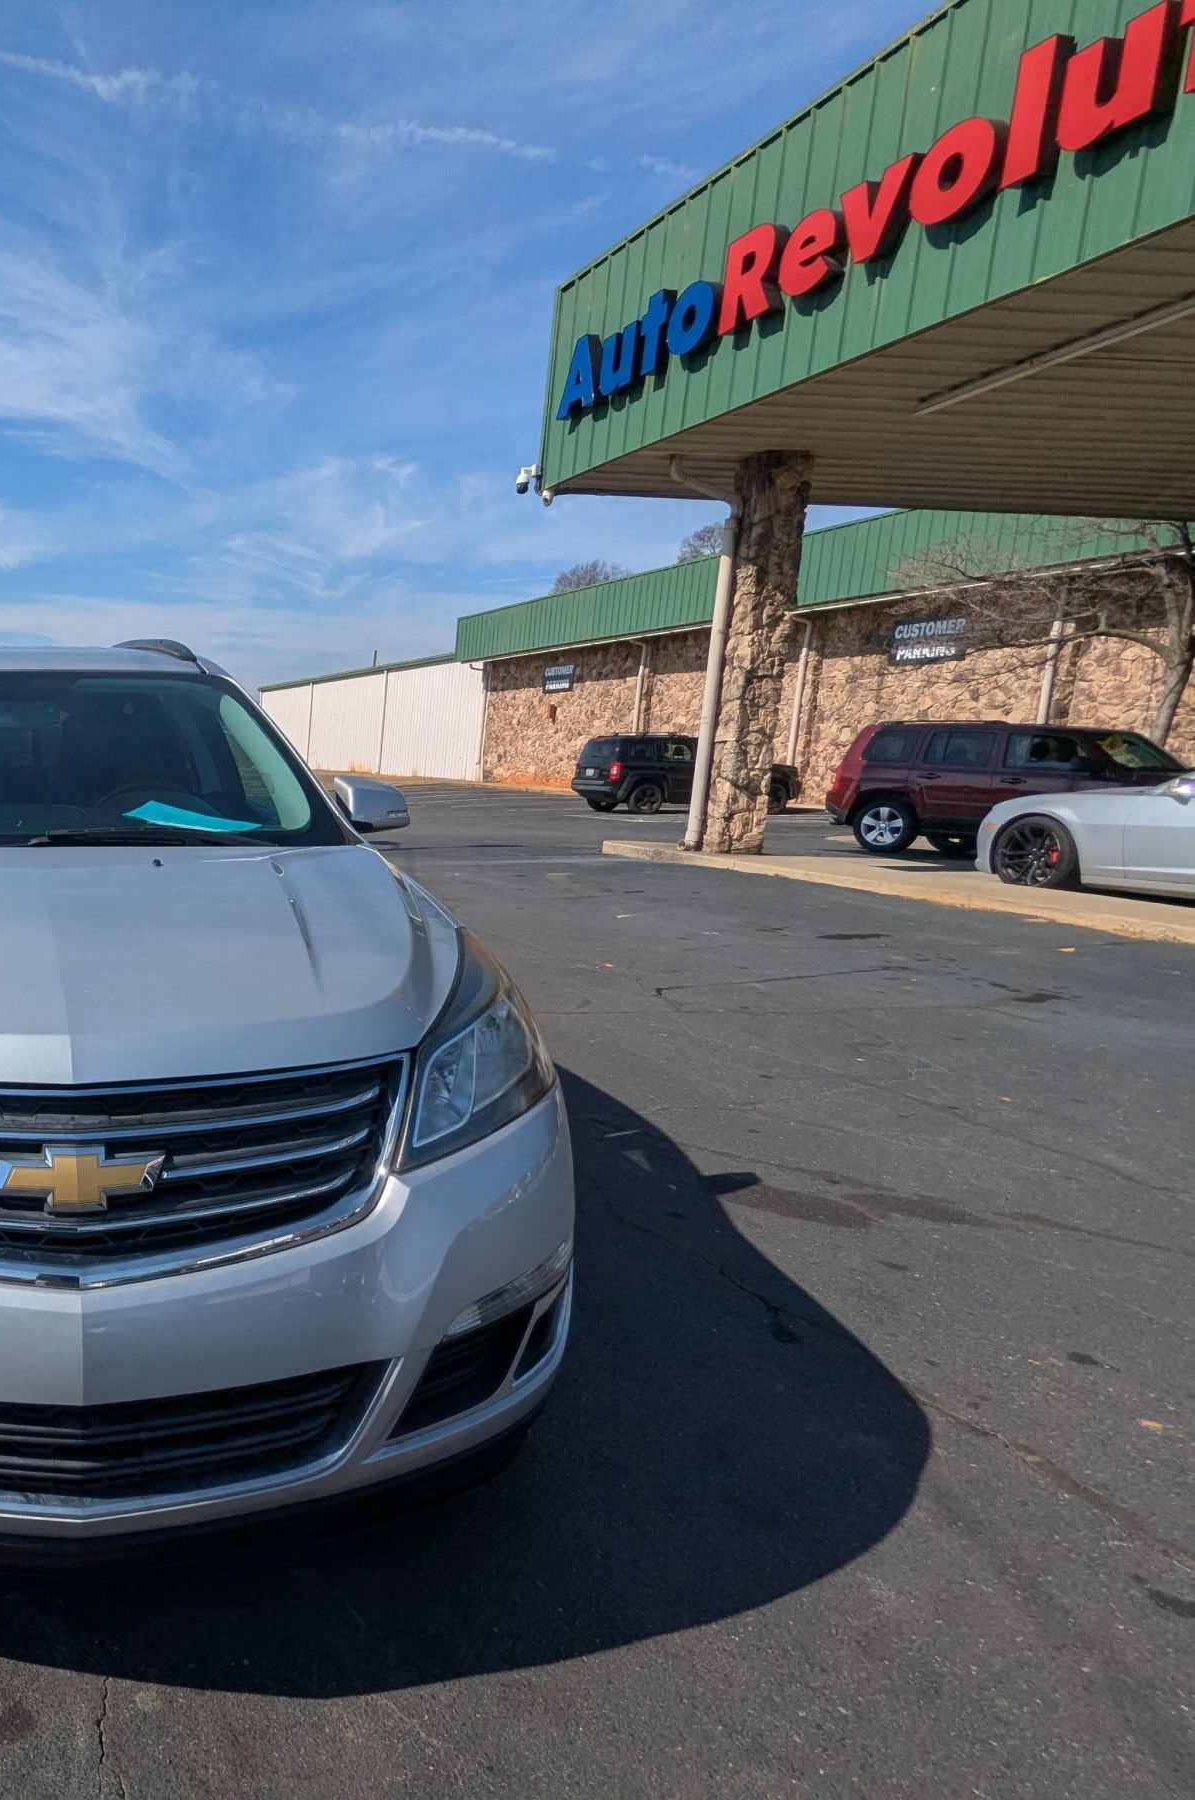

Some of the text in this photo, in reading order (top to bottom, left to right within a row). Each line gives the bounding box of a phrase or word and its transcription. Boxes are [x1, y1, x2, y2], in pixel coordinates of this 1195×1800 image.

[894, 618, 966, 640] CUSTOMER
[894, 641, 956, 661] PARKING
[545, 664, 574, 677] CUSTOMER
